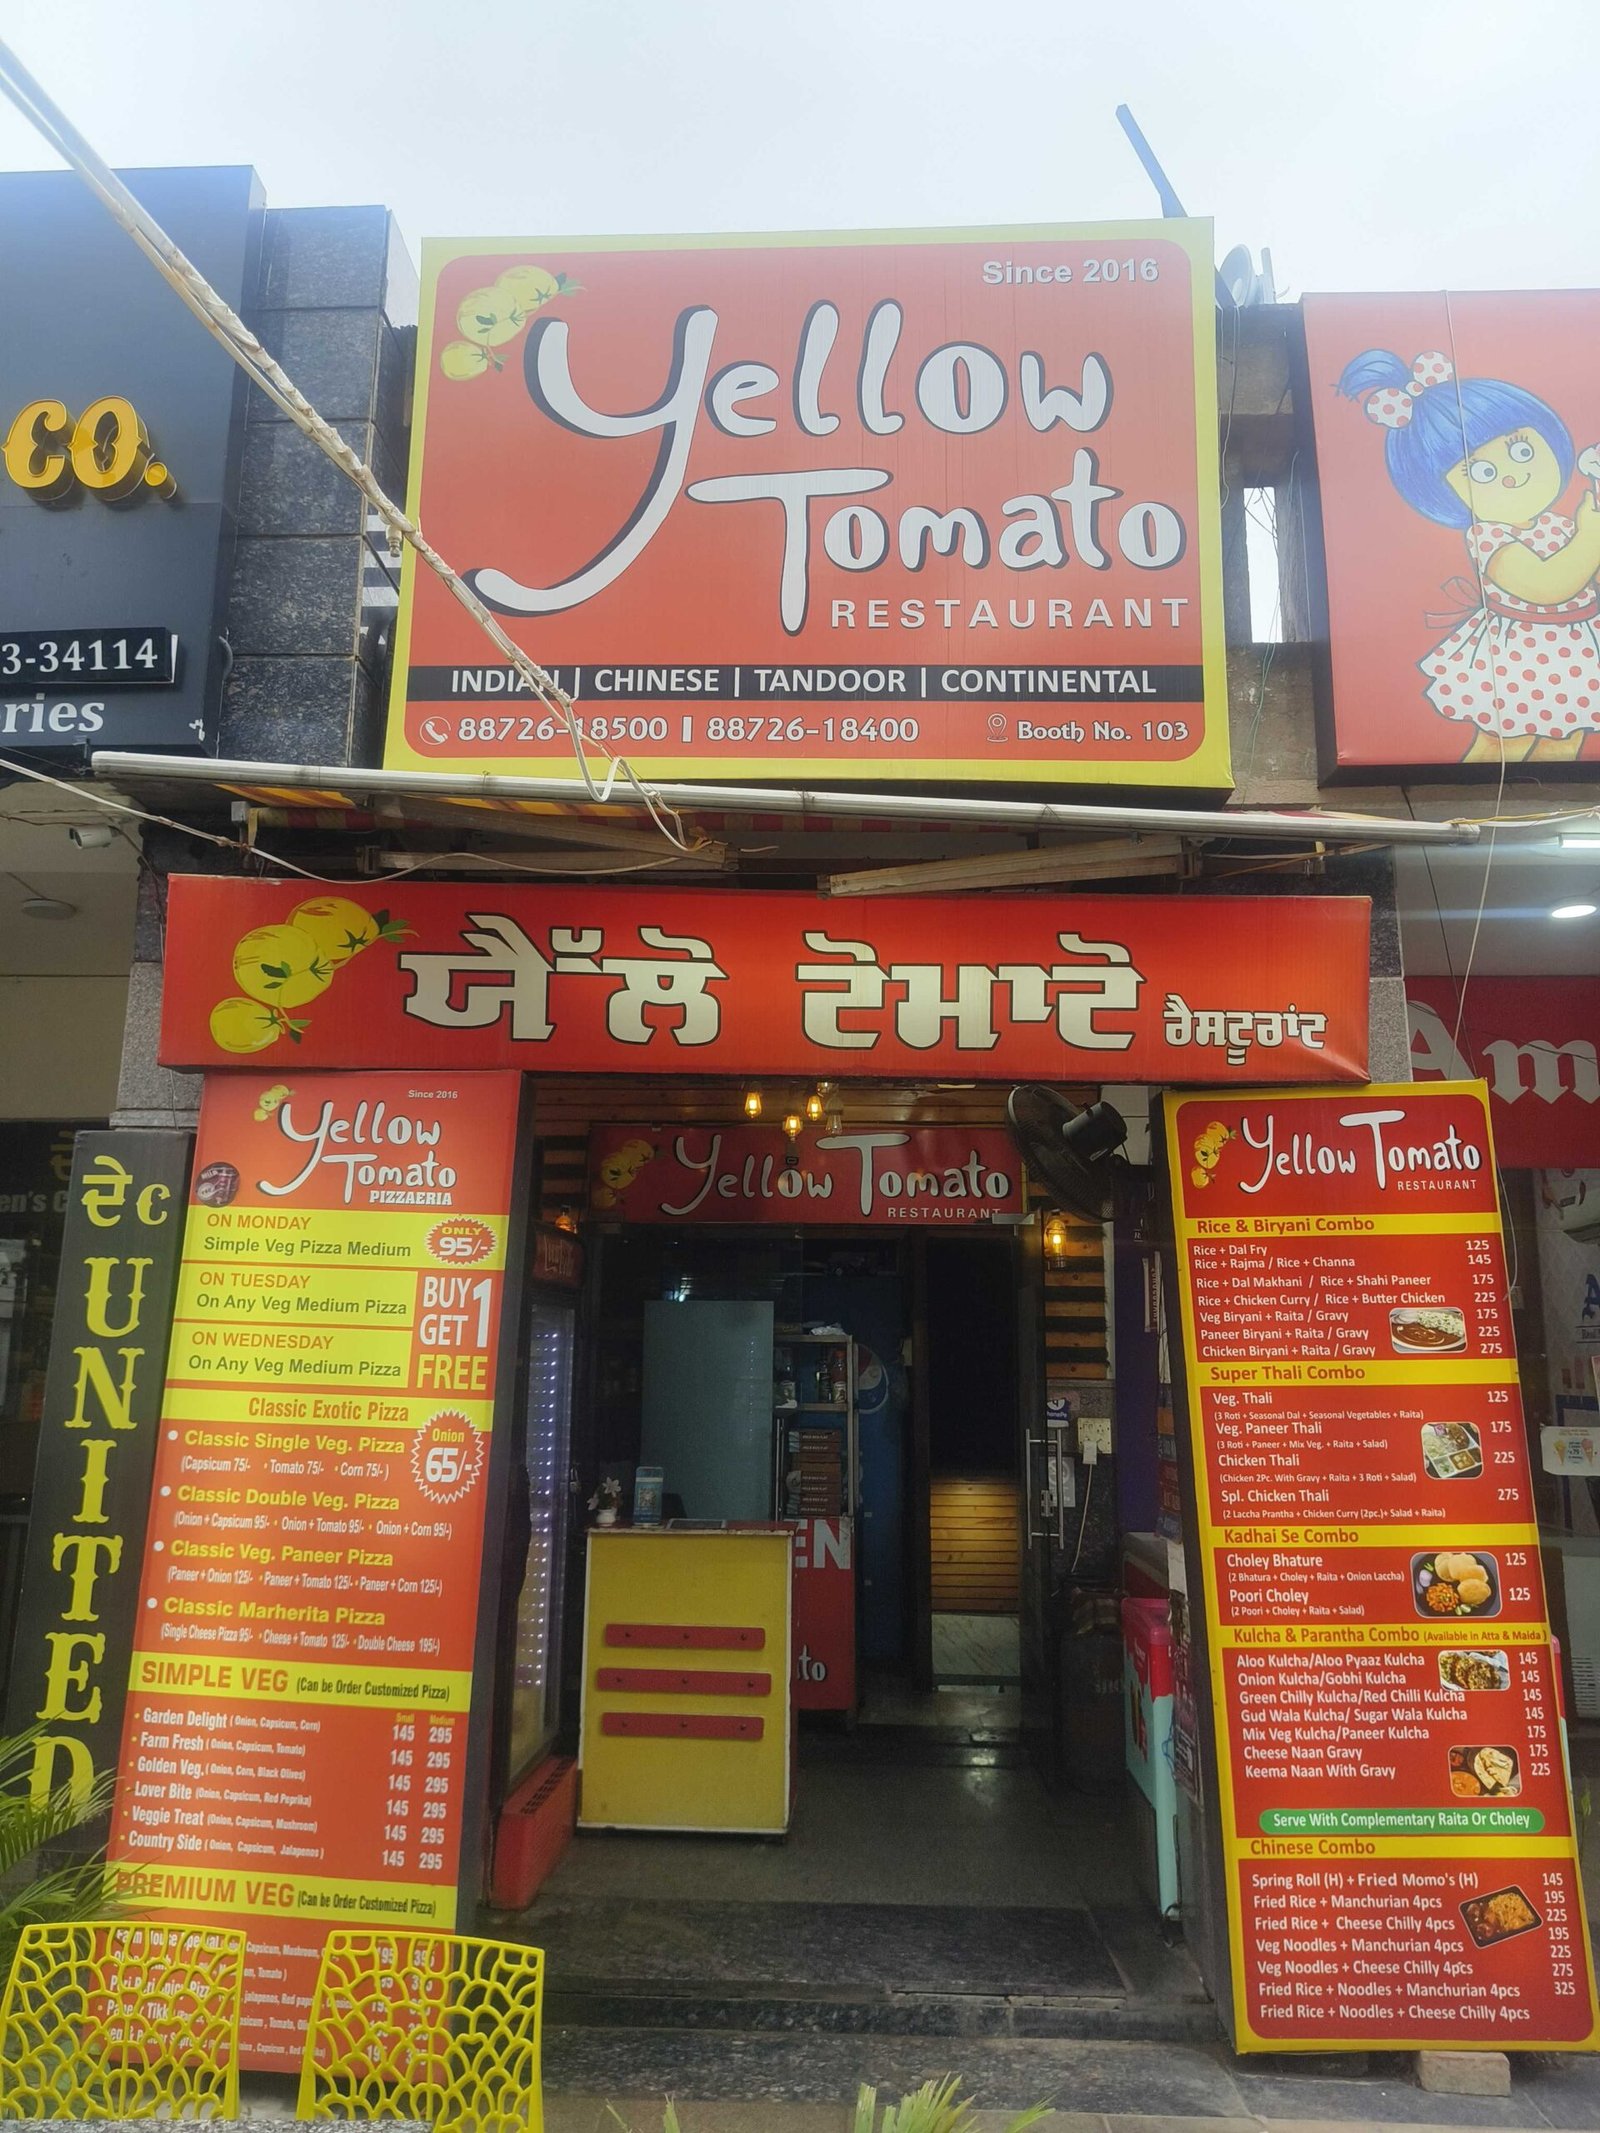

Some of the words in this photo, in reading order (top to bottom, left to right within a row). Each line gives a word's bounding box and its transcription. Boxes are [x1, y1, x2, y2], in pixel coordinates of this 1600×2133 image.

[981, 258, 1073, 285] Since
[1082, 257, 1160, 284] 2016
[467, 298, 1112, 616] Yellow
[686, 446, 1187, 637] Tomato
[830, 598, 1189, 629] RESTAURANT
[594, 669, 720, 692] CHINESE
[754, 668, 906, 694] TANDOOR
[940, 669, 1157, 695] CONTINENTAL
[706, 717, 919, 744] 88726-18400
[1016, 720, 1085, 744] Booth
[1094, 721, 1133, 742] No.
[1142, 720, 1189, 742] 103
[408, 1090, 433, 1098] Since
[436, 1090, 458, 1099] 2016
[258, 1100, 442, 1196] Yellow
[1239, 1114, 1356, 1193] Yellow
[1339, 1110, 1481, 1190] Tomato
[321, 1150, 457, 1204] Tomato
[661, 1133, 832, 1217] Yellow
[816, 1132, 1011, 1217] Tomato
[1398, 1179, 1477, 1191] RESTAURANT
[369, 1190, 452, 1205] PIZZAERIA
[207, 1214, 234, 1228] ON
[237, 1215, 311, 1230] MONDAY
[888, 1207, 1001, 1219] RESTAURANT
[442, 1227, 481, 1236] ONLY
[1197, 1219, 1232, 1234] Rice
[1236, 1219, 1249, 1233] &
[1254, 1218, 1311, 1235] Biryani
[1315, 1217, 1374, 1231] Combo
[204, 1237, 259, 1252] Simple
[265, 1240, 295, 1256] Veg
[300, 1241, 342, 1255] Pizza
[347, 1242, 411, 1257] Medium
[439, 1238, 488, 1256] 95/-
[200, 1272, 227, 1286] ON
[231, 1273, 310, 1288] TUESDAY
[197, 1294, 219, 1308] On
[224, 1295, 255, 1311] Any
[261, 1297, 291, 1313] Veg
[296, 1298, 359, 1313] Medium
[365, 1300, 407, 1314] Pizza
[423, 1277, 471, 1307] BUY
[472, 1278, 492, 1347] 1
[419, 1315, 468, 1345] GET
[192, 1332, 219, 1345] ON
[223, 1333, 333, 1349] WEDNESDAY
[189, 1355, 211, 1369] On
[216, 1358, 248, 1373] Any
[254, 1358, 284, 1375] Veg
[289, 1359, 352, 1375] Medium
[359, 1362, 400, 1376] Pizza
[417, 1354, 488, 1390] FREE
[1211, 1367, 1257, 1383] Super
[1261, 1366, 1302, 1380] Thali
[1307, 1365, 1365, 1380] Combo
[1213, 1392, 1239, 1406] Veg.
[1242, 1391, 1273, 1405] Thali
[1487, 1391, 1508, 1403] 125
[249, 1397, 307, 1417] Classic
[313, 1400, 361, 1420] Exotic
[368, 1402, 409, 1421] Pizza
[433, 1429, 464, 1442] Onion
[1215, 1422, 1242, 1436] Veg.
[1246, 1422, 1288, 1435] Paneer
[1292, 1422, 1322, 1434] Thali
[1490, 1421, 1511, 1433] 175
[185, 1430, 248, 1447] Classic
[255, 1433, 309, 1451] Single
[315, 1436, 352, 1452] Veg.
[359, 1437, 405, 1453] Pizza
[270, 1460, 304, 1475] Tomato
[341, 1463, 363, 1476] Corn
[425, 1447, 472, 1482] 65/-
[1218, 1454, 1266, 1467] Chicken
[1270, 1454, 1299, 1466] Thali
[1494, 1452, 1515, 1464] 225
[1221, 1490, 1244, 1504] Spl.
[1247, 1489, 1295, 1502] Chicken
[1299, 1489, 1329, 1502] Thali
[1498, 1489, 1519, 1500] 275
[1224, 1529, 1277, 1544] Kadhai
[1281, 1529, 1299, 1543] Se
[1304, 1528, 1359, 1543] Combo
[1227, 1554, 1269, 1569] Choley
[1274, 1554, 1323, 1567] Bhature
[1505, 1553, 1527, 1565] 125
[1230, 1589, 1262, 1603] Poori
[1265, 1589, 1309, 1603] Choley
[1509, 1588, 1530, 1600] 125
[1234, 1628, 1281, 1643] Kulcha
[1285, 1629, 1296, 1642] &
[1302, 1629, 1364, 1643] Parantha
[1369, 1629, 1419, 1642] Combo
[1424, 1630, 1467, 1642] (Available
[1482, 1631, 1499, 1640] Atta
[1502, 1631, 1510, 1640] &
[142, 1661, 232, 1688] SIMPLE
[241, 1667, 288, 1692] VEG
[297, 1677, 319, 1693] (Can
[322, 1677, 333, 1694] be
[336, 1678, 362, 1696] Order
[365, 1680, 418, 1698] Customized
[422, 1683, 450, 1701] Pizza)
[144, 1708, 183, 1726] Garden
[187, 1711, 227, 1729] Delight
[392, 1725, 414, 1742] 145
[429, 1727, 452, 1744] 295
[1244, 1747, 1287, 1759] Cheese
[1291, 1747, 1323, 1758] Naan
[1327, 1747, 1362, 1761] Gravy
[1529, 1745, 1548, 1757] 175
[1246, 1766, 1287, 1779] Keema
[1290, 1765, 1324, 1778] Naan
[1327, 1765, 1356, 1777] With
[1359, 1765, 1395, 1780] Gravy
[1531, 1763, 1550, 1776] 225
[1274, 1814, 1307, 1827] Serve
[1309, 1813, 1338, 1826] With
[1341, 1814, 1435, 1828] Complementary
[1439, 1813, 1468, 1826] Raita
[1471, 1813, 1486, 1825] Or
[1489, 1813, 1530, 1828] Choley
[1251, 1841, 1313, 1855] Chinese
[1318, 1841, 1375, 1855] Combo
[246, 1881, 294, 1907] VEG
